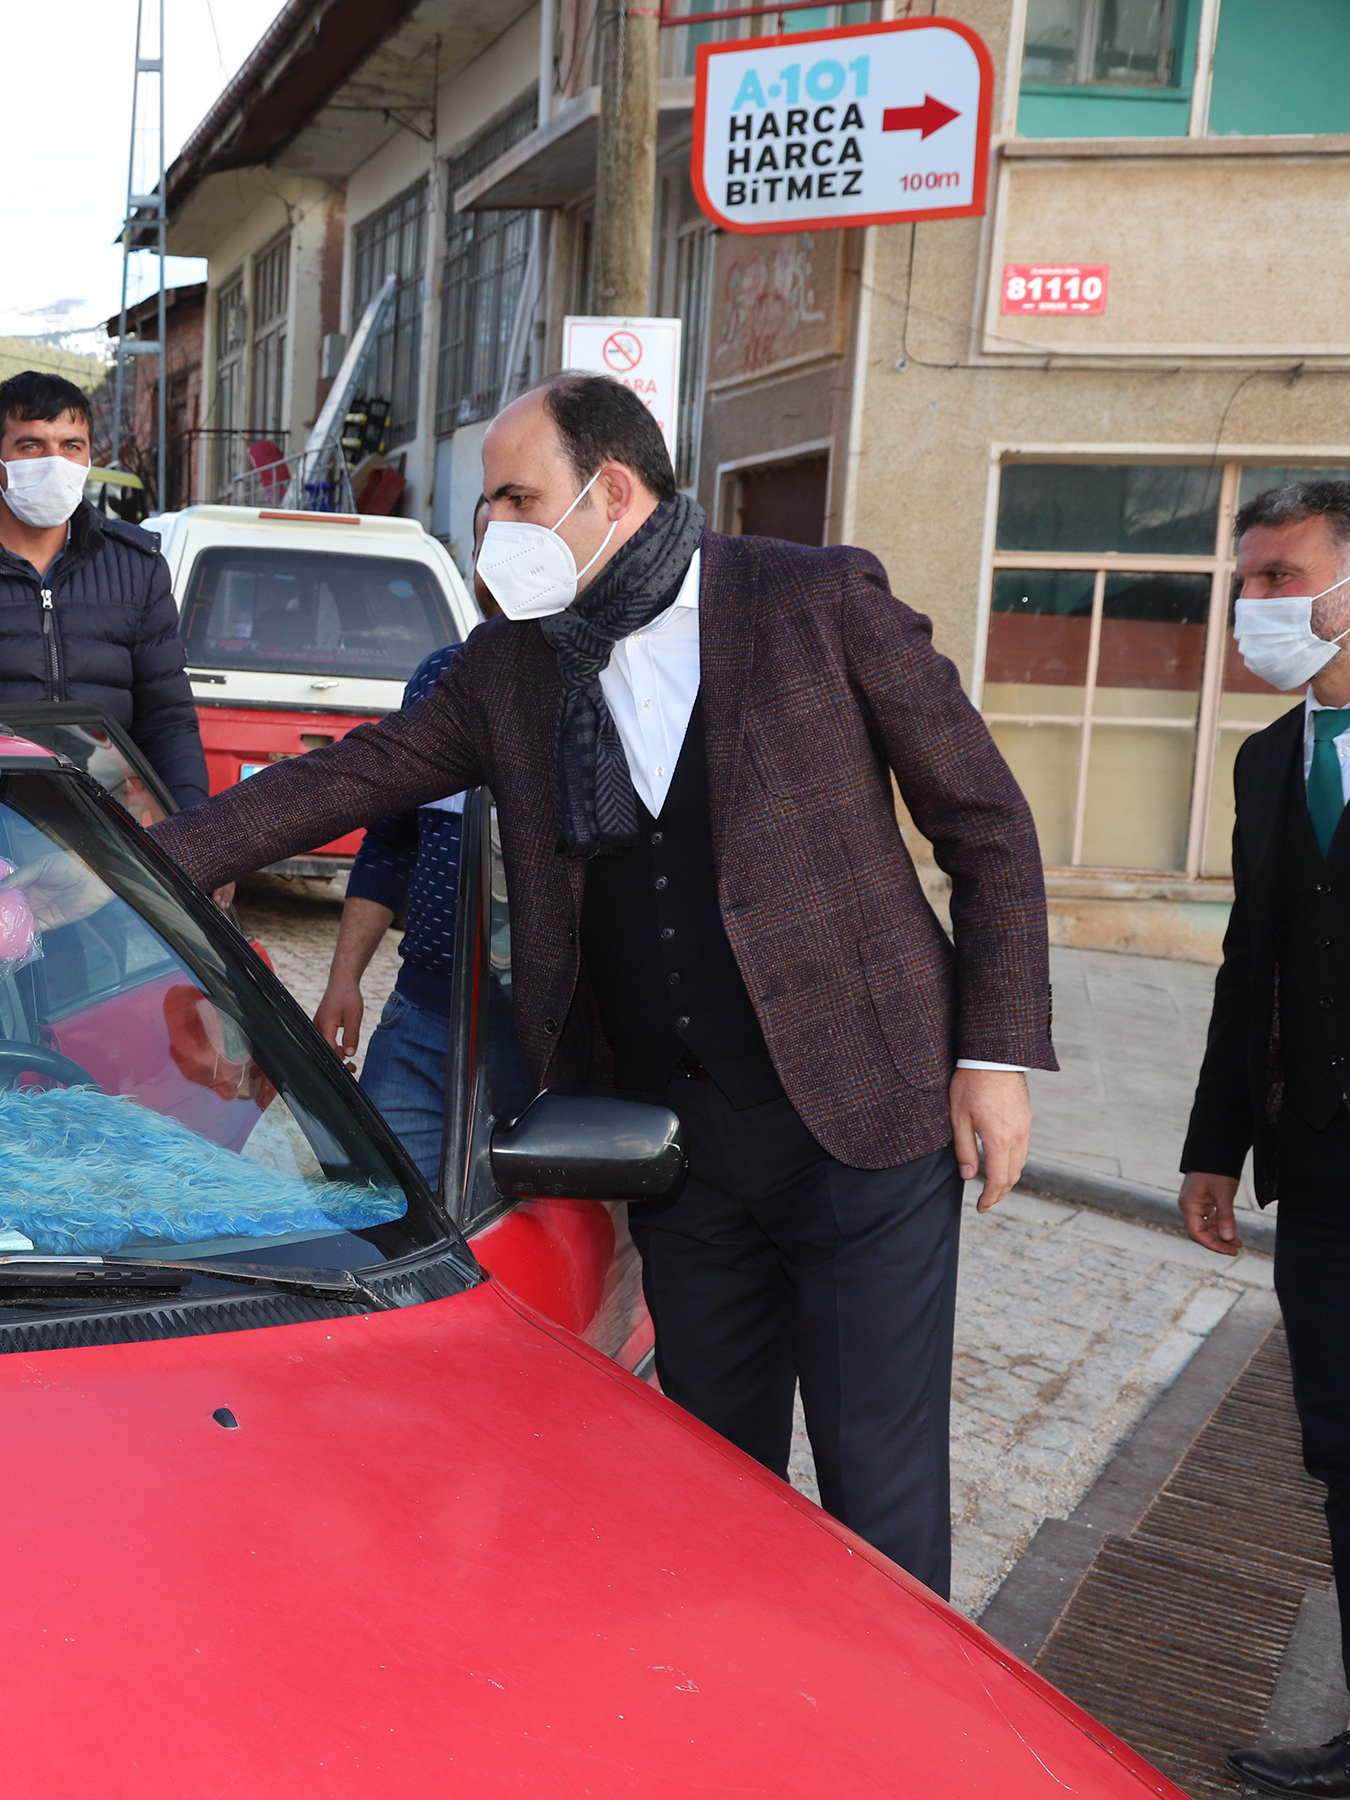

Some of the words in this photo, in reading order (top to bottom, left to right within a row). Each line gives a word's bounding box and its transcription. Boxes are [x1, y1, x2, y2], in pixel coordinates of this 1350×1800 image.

[729, 102, 865, 143] HARCA
[727, 136, 863, 175] HARCA
[900, 171, 960, 192] 100m
[1007, 276, 1103, 301] 81110
